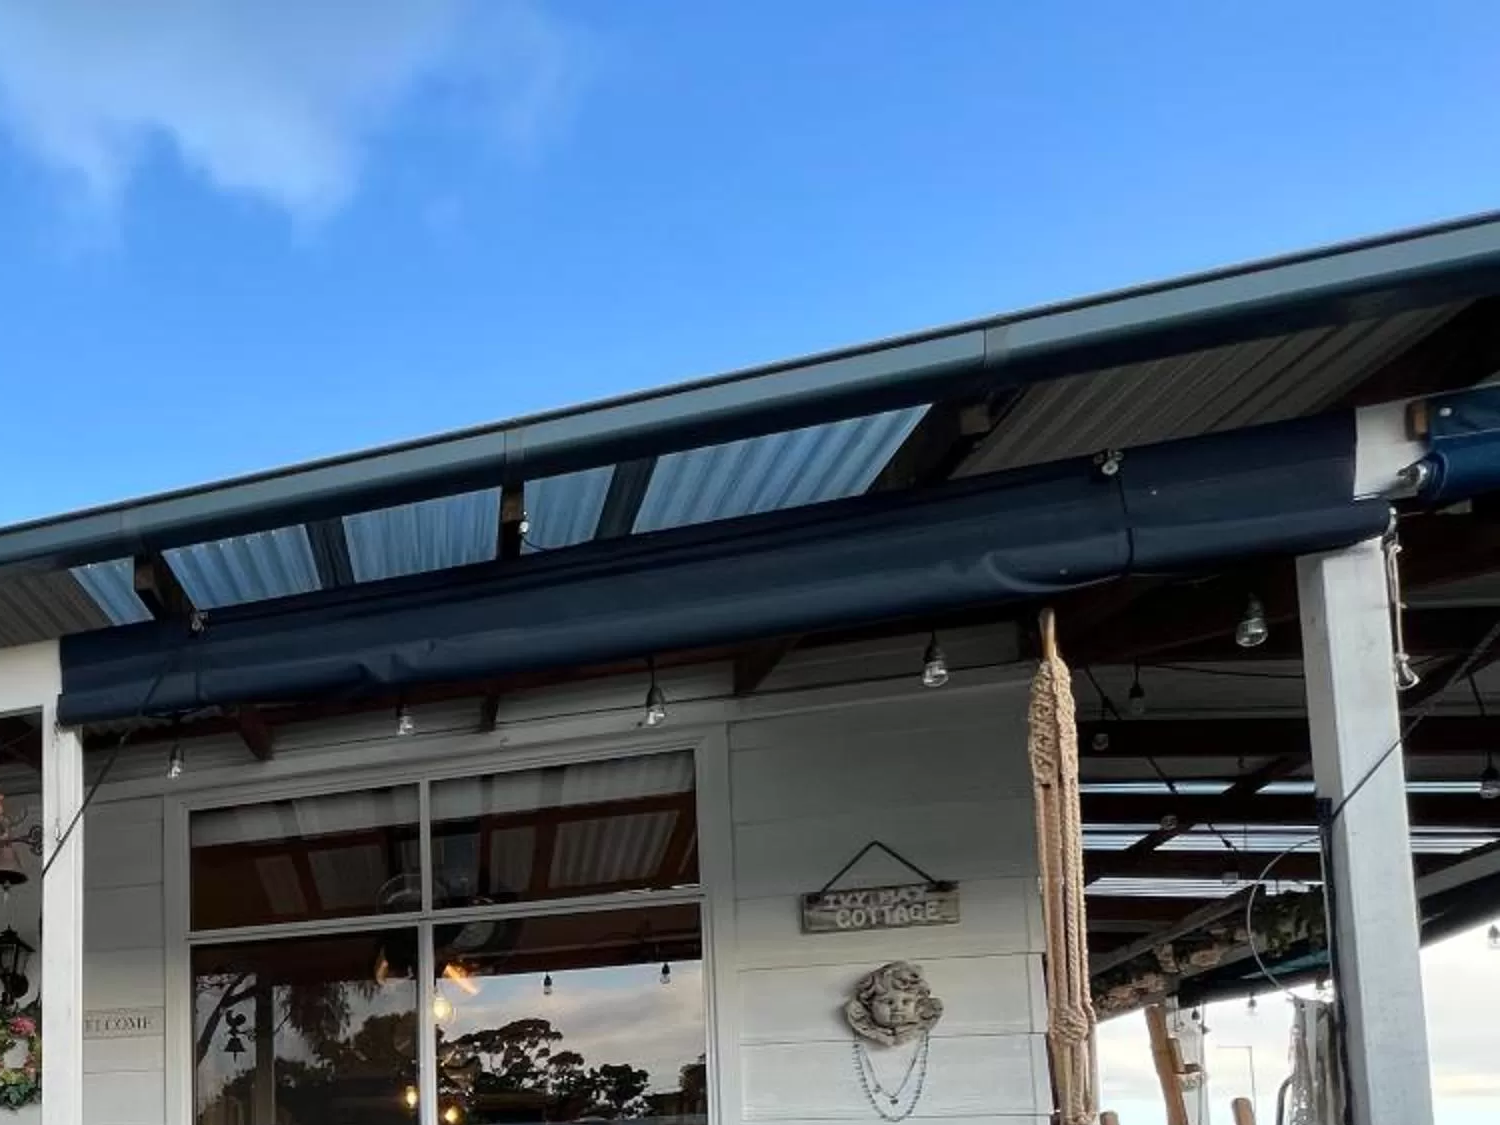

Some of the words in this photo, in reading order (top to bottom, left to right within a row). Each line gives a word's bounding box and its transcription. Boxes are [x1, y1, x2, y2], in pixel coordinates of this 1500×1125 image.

[825, 892, 869, 909] IVY
[836, 902, 941, 928] COTTAGE
[85, 1016, 152, 1032] ELCOME
